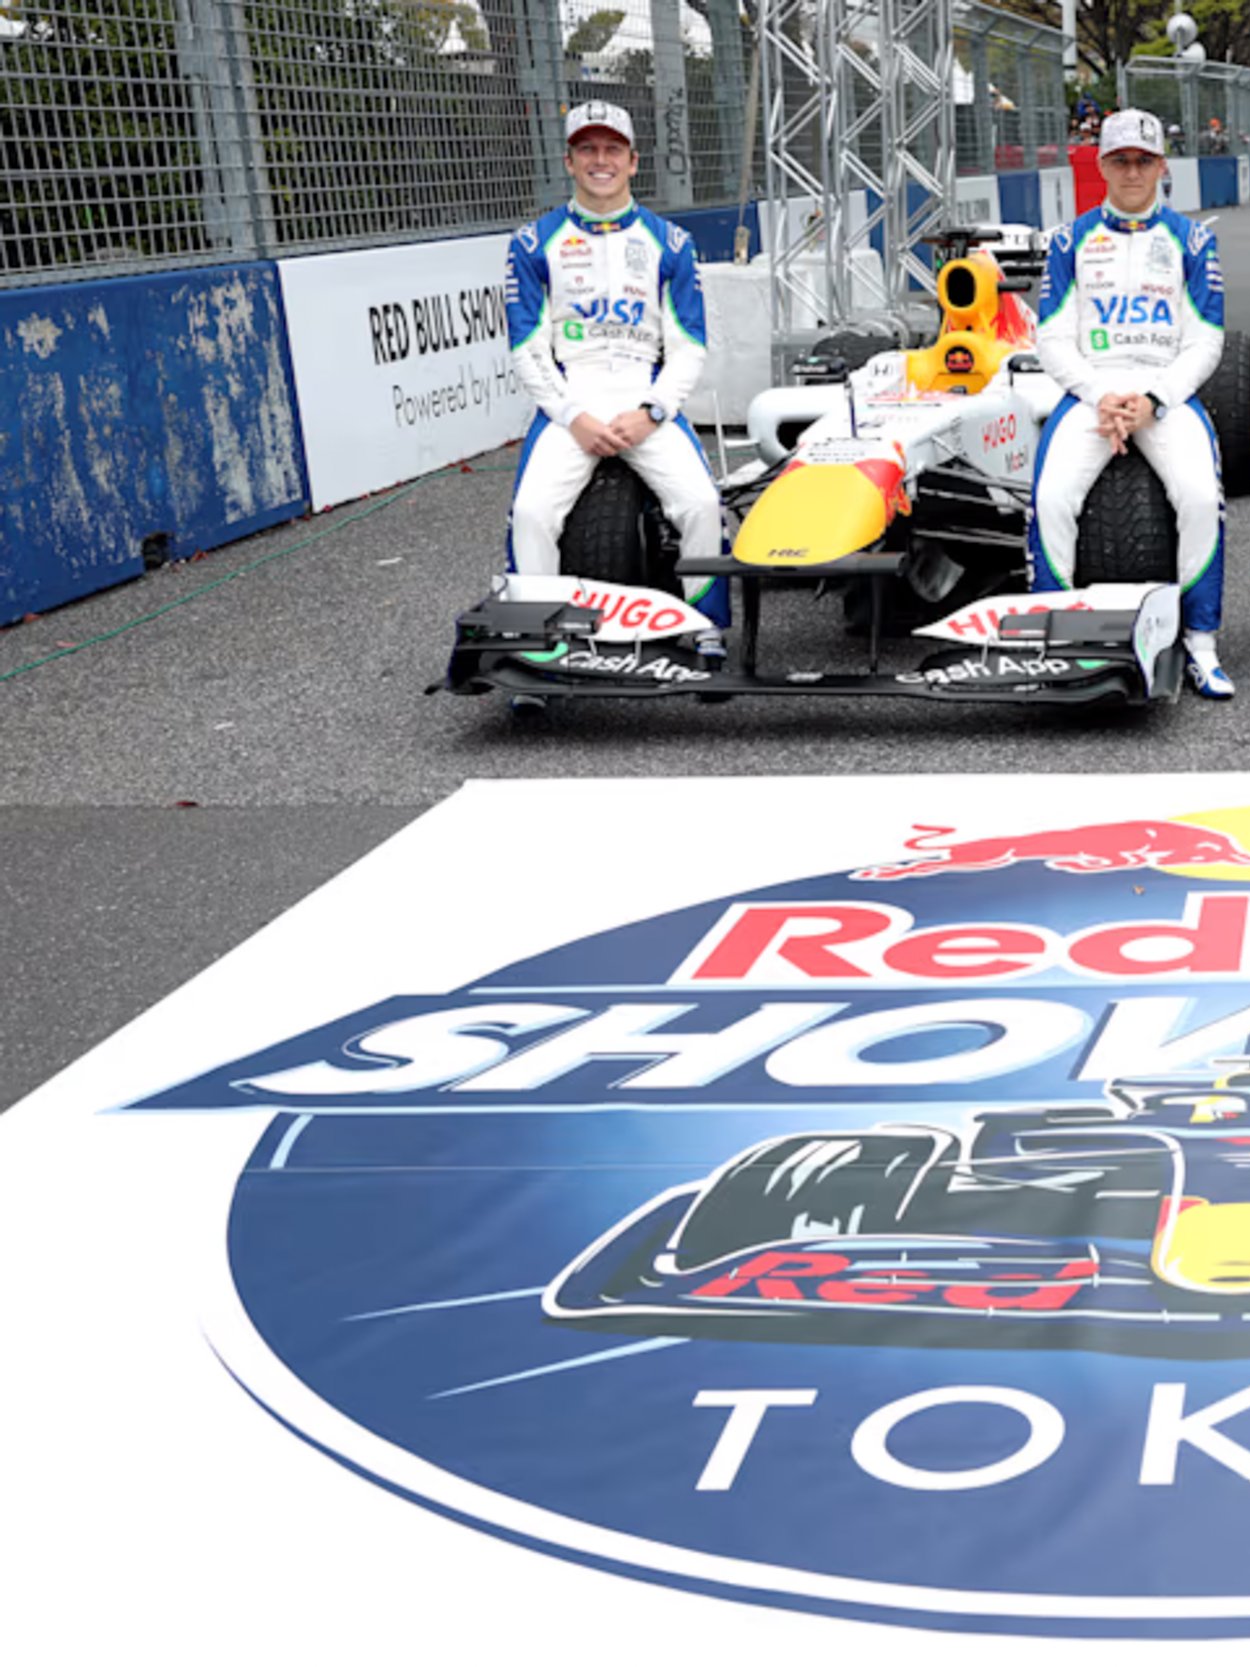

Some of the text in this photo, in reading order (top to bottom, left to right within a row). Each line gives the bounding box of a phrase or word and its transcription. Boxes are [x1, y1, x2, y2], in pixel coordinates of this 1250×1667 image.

[570, 297, 646, 326] VISA
[1091, 296, 1174, 326] VISA
[369, 302, 411, 366] RED
[411, 293, 460, 355] BULL
[1114, 333, 1148, 346] Cash
[392, 365, 467, 428] Powered
[469, 362, 491, 417] by
[982, 413, 1017, 455] HUGO
[558, 651, 641, 675] Cash
[895, 655, 1071, 684] Cash App
